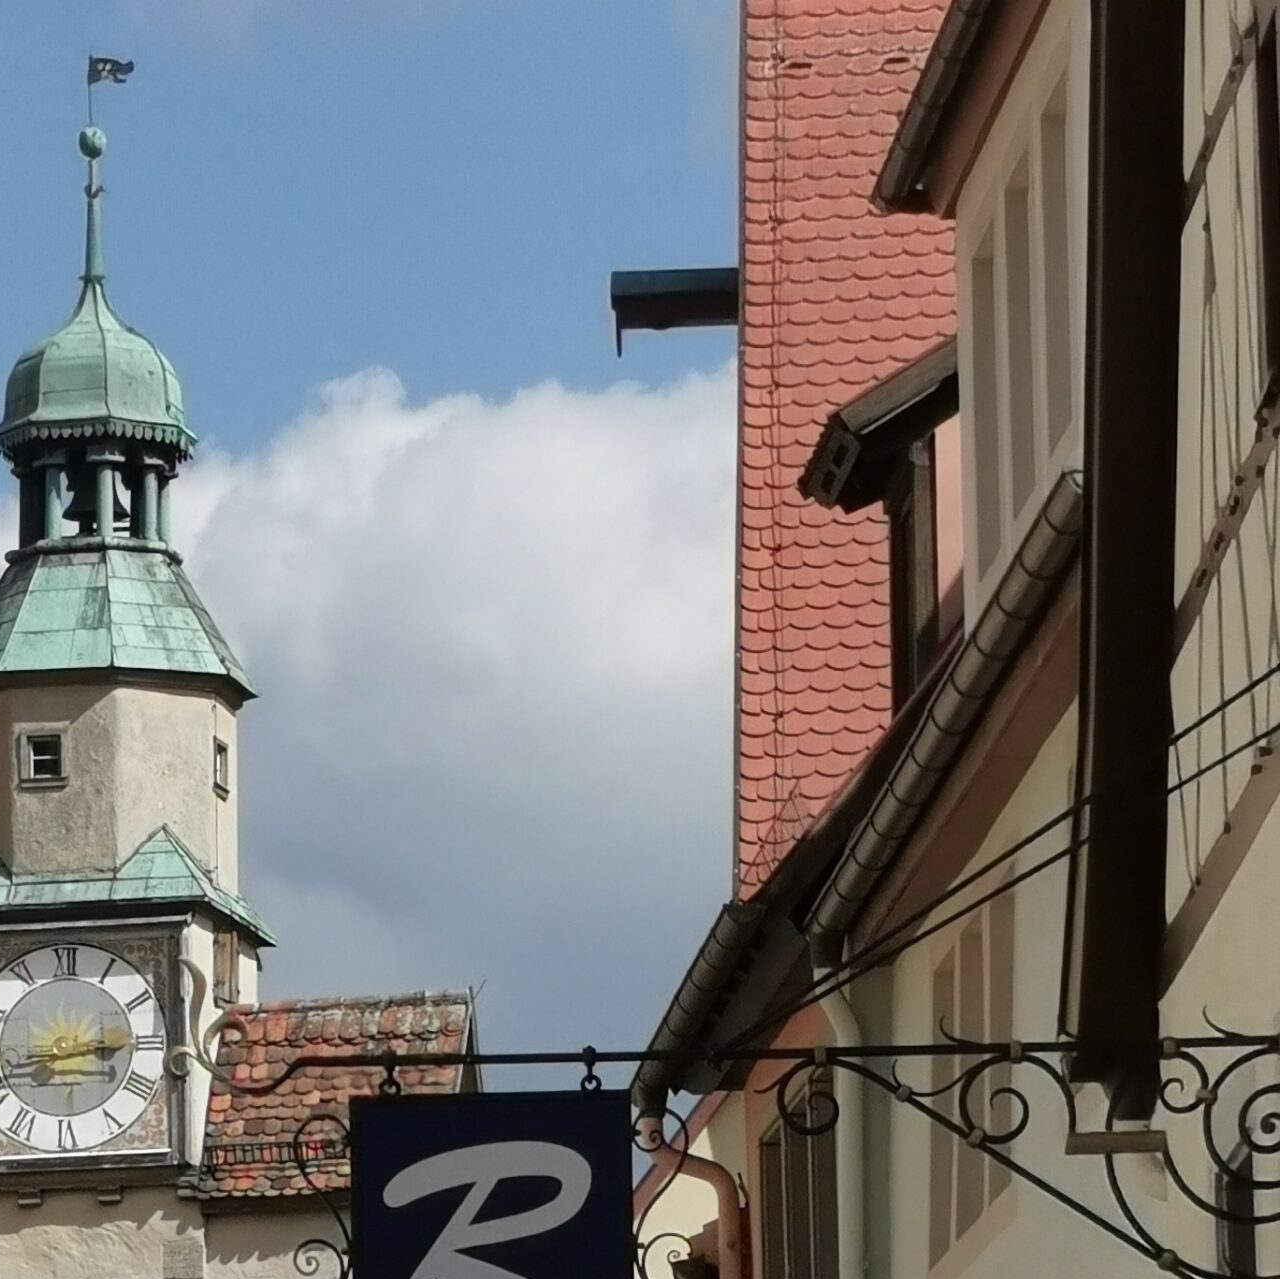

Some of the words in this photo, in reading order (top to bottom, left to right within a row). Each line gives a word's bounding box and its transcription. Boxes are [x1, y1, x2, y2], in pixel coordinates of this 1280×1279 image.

[52, 947, 79, 977] XII
[98, 957, 118, 985] I
[123, 987, 154, 1014] II
[136, 1034, 165, 1052] III
